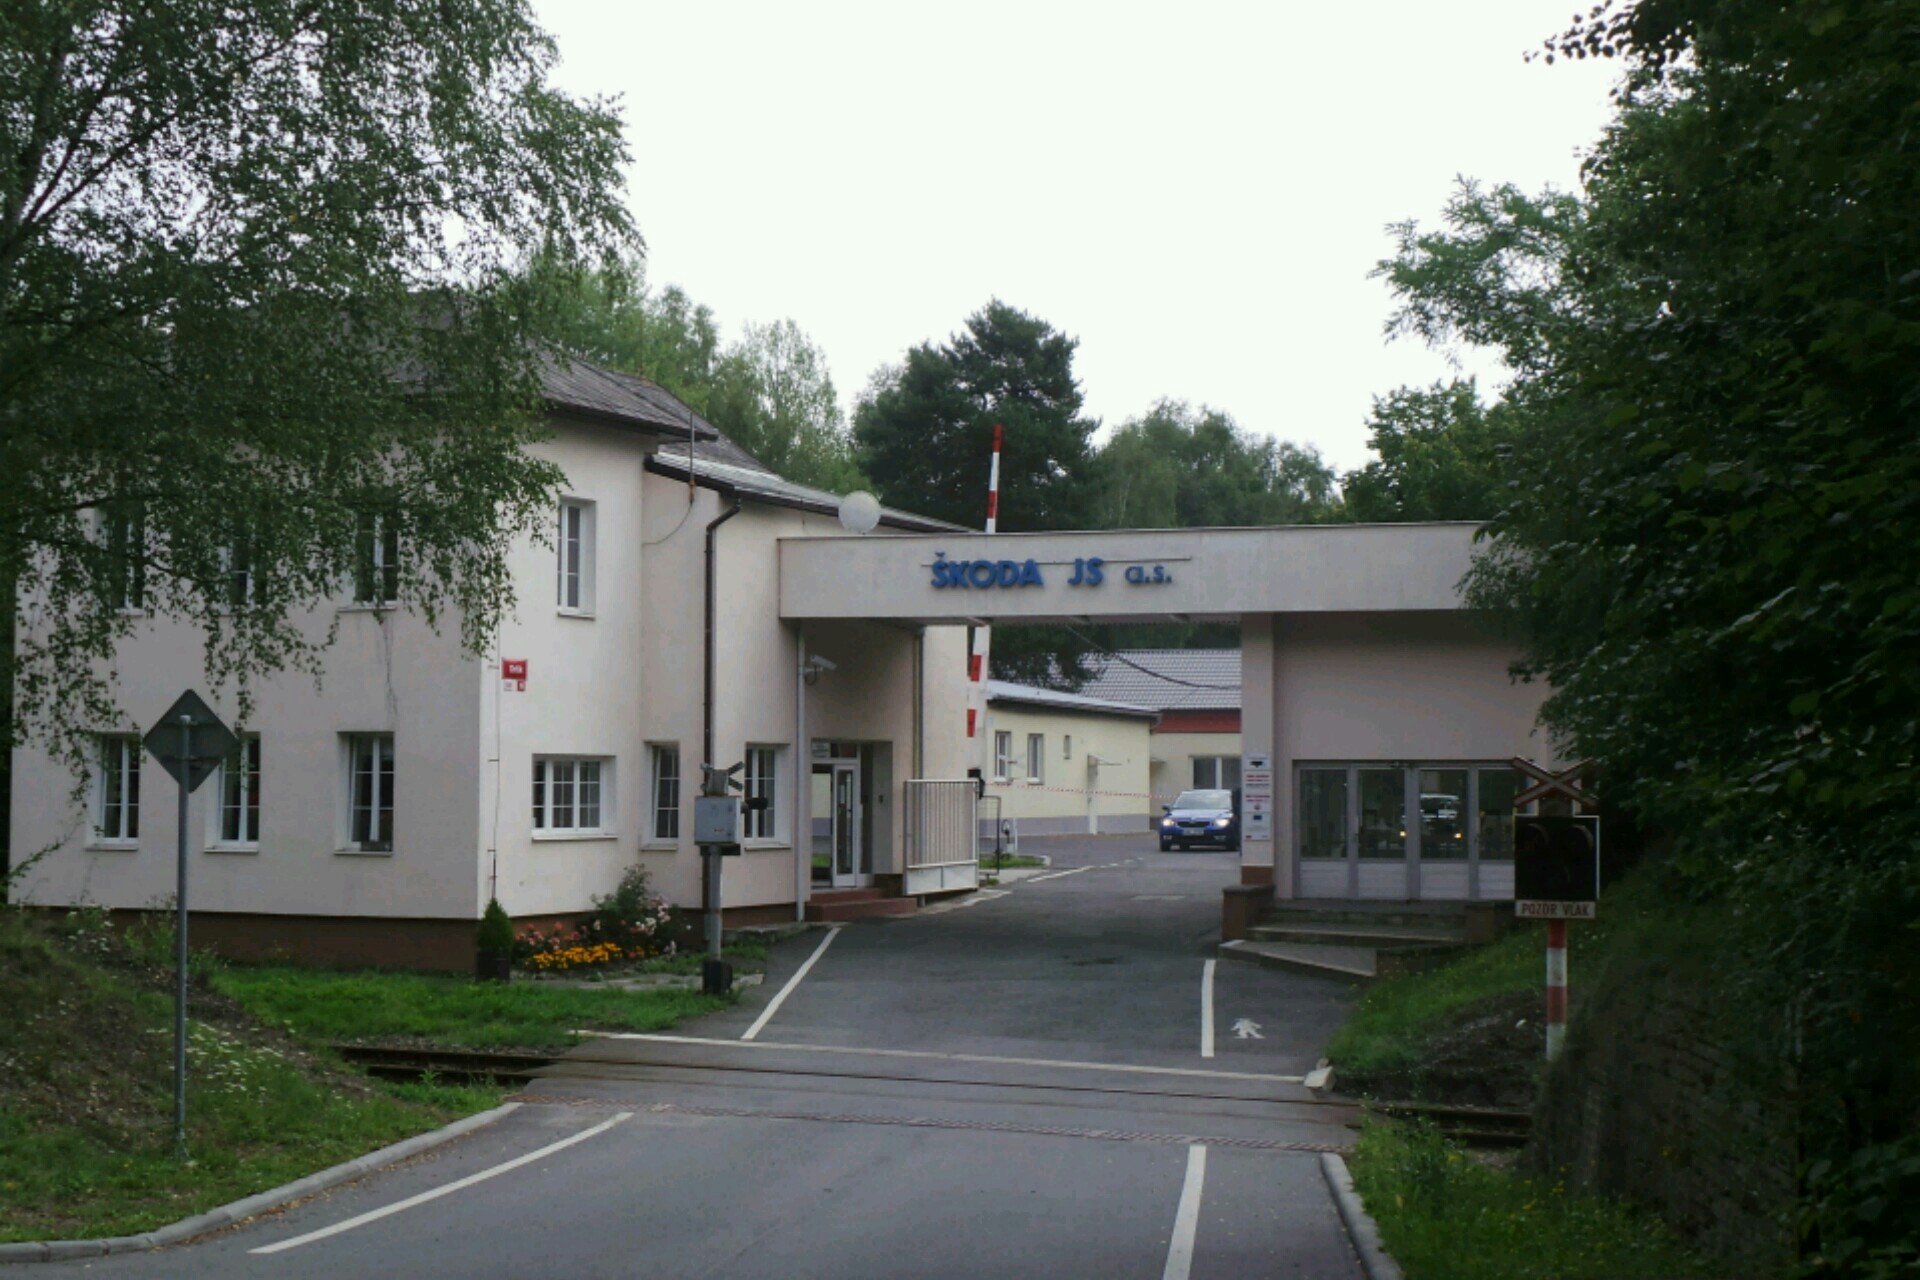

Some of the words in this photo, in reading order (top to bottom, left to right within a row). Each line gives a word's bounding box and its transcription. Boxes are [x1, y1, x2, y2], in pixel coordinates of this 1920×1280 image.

[931, 552, 1043, 588] ŠKODA
[1067, 557, 1104, 587] JS
[1125, 564, 1173, 585] a.s.
[1521, 902, 1558, 915] POZOR
[1562, 903, 1591, 916] VLAK
